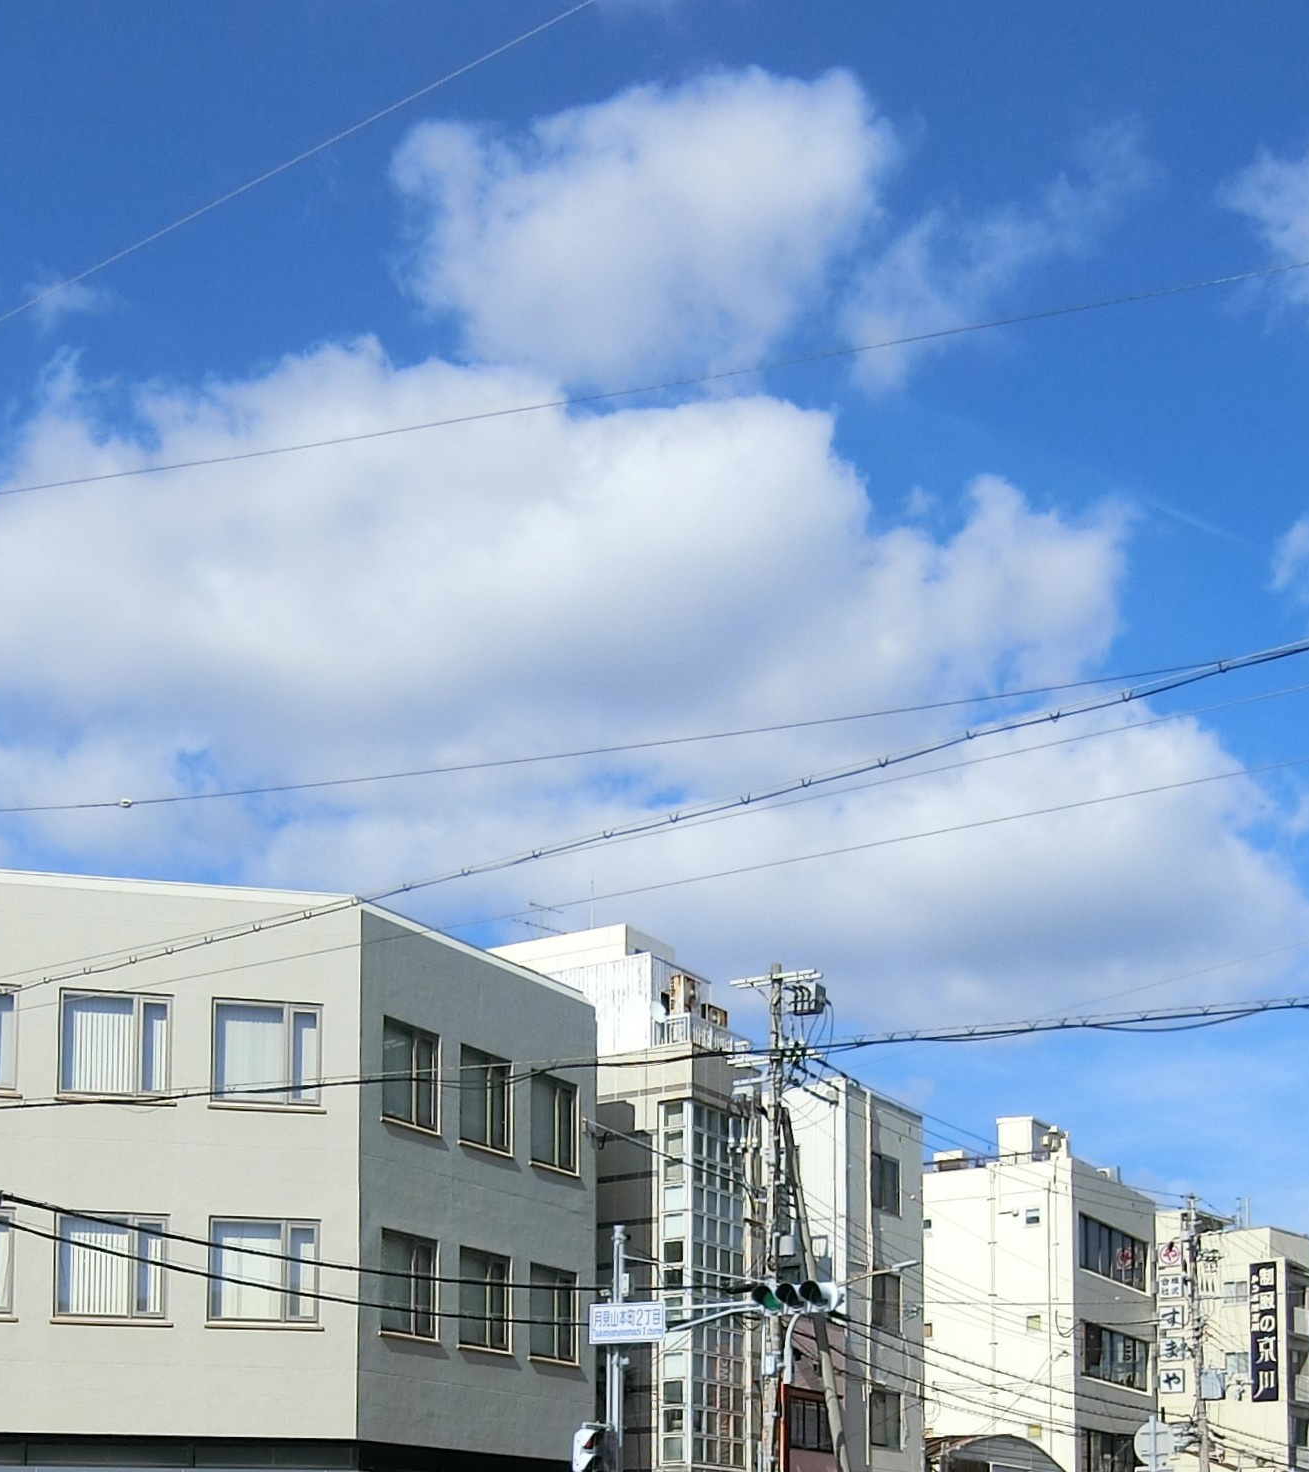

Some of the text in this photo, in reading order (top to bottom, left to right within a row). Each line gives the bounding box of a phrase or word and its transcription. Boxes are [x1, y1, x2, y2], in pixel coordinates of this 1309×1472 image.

[595, 1308, 660, 1327] 月見山本町2丁目
